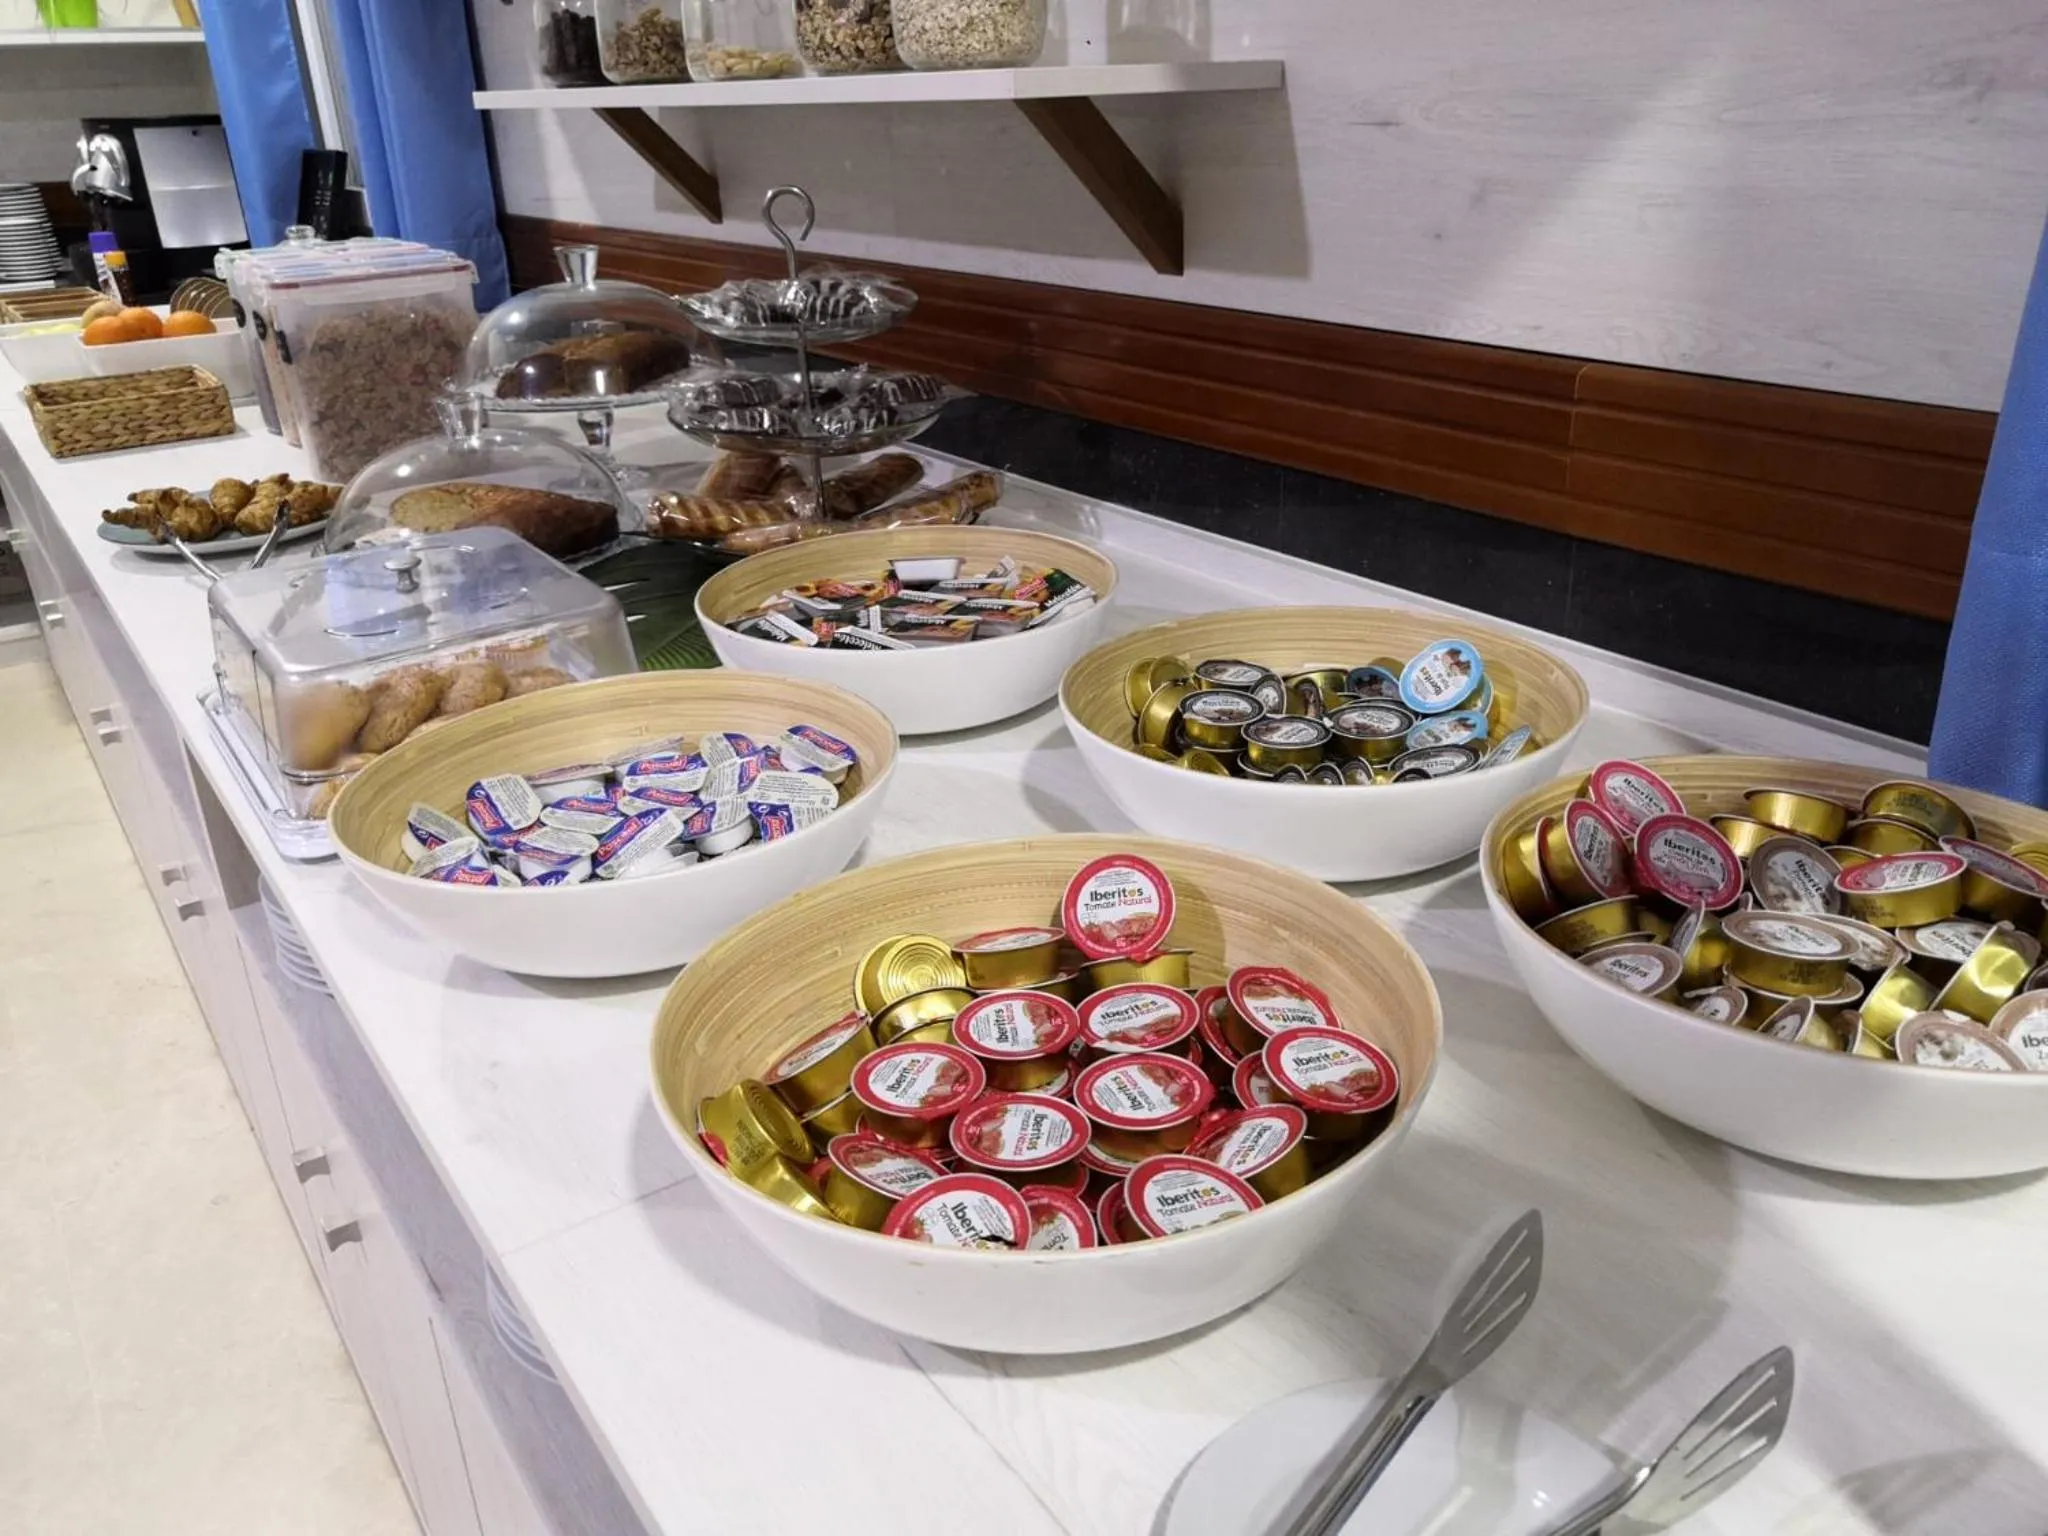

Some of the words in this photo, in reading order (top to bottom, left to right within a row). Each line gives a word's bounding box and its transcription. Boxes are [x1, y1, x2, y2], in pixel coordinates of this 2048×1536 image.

[1664, 838, 1716, 865] Iberitos
[1084, 901, 1117, 912] Tomate
[1118, 895, 1152, 907] Natural
[1090, 887, 1144, 902] Iberitos
[1100, 1000, 1158, 1020] Iberitos
[993, 1008, 1009, 1044] Iberitos
[1292, 1050, 1350, 1067] Iberitos
[885, 1059, 921, 1093] Iberitos
[1110, 1075, 1145, 1111] Iberitos
[1027, 1113, 1048, 1151] Iberitos
[1156, 1186, 1221, 1208] Iberitos
[1156, 1203, 1197, 1217] Tomate
[1195, 1193, 1235, 1209] Natural
[937, 1202, 964, 1241] Tomate
